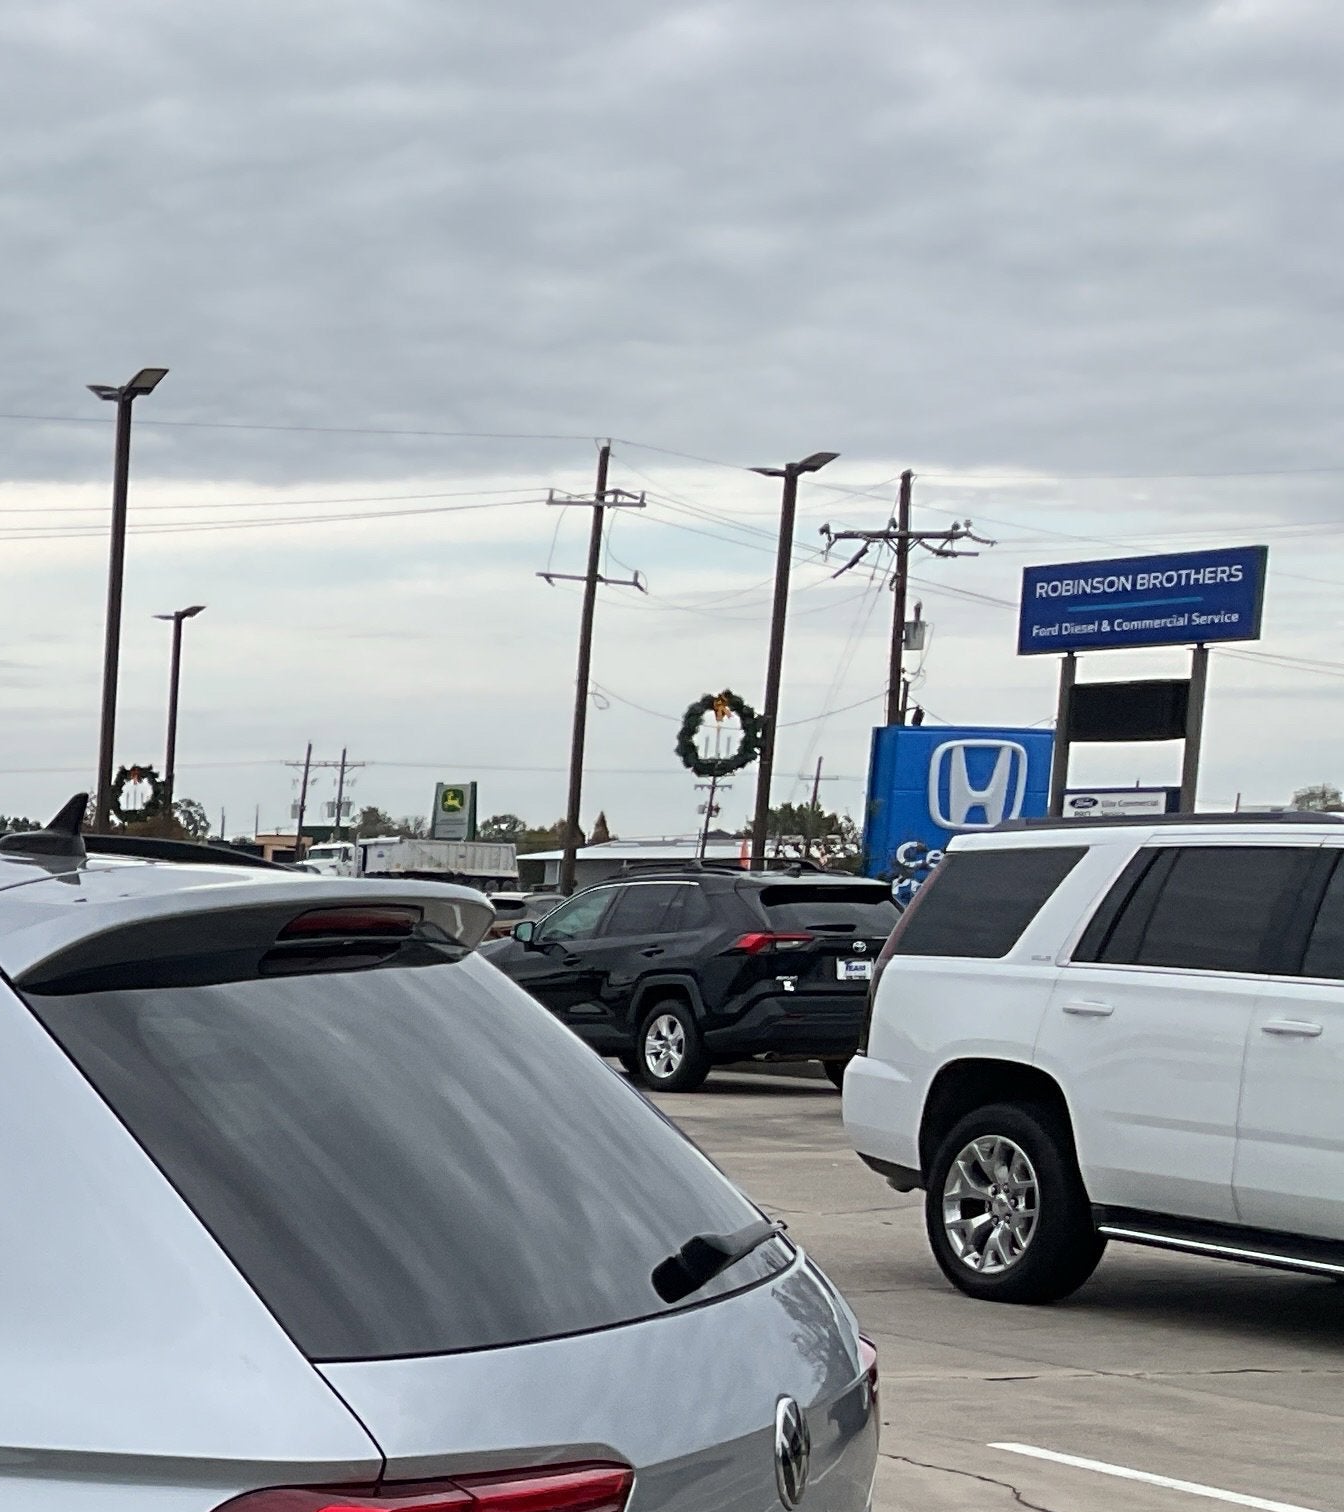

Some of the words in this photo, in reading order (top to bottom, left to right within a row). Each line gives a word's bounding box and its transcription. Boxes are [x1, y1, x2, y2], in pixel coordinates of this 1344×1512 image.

[1035, 575, 1132, 599] ROBINSON
[1135, 564, 1243, 591] BROTHERS
[1032, 624, 1059, 637] Ford
[1062, 620, 1098, 635] Diesel
[1101, 622, 1111, 632] &
[1114, 613, 1188, 631] Commercial
[1191, 611, 1239, 625] Service
